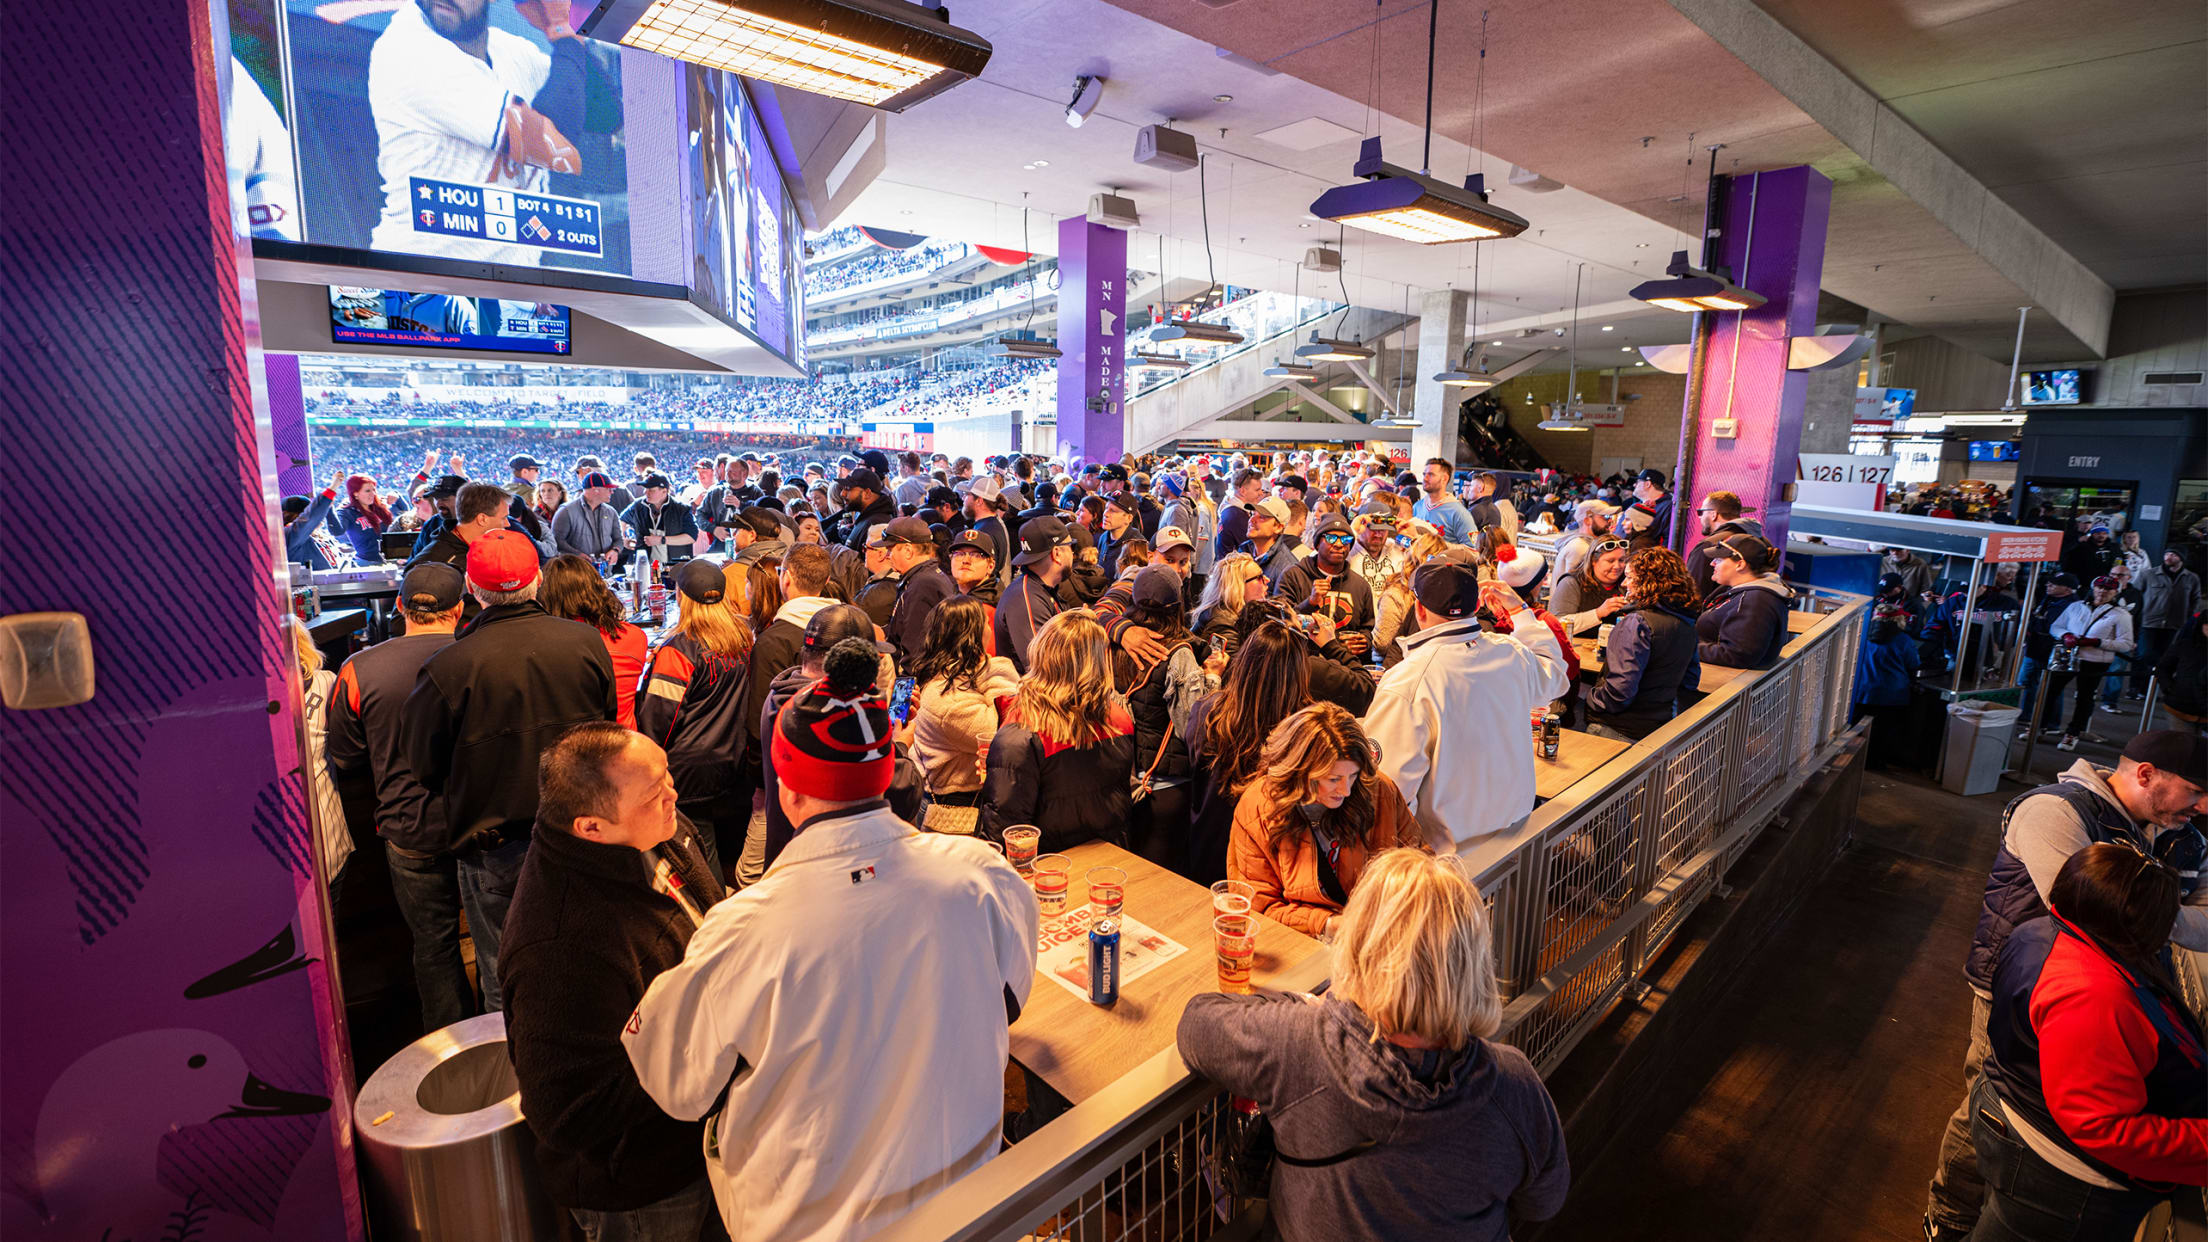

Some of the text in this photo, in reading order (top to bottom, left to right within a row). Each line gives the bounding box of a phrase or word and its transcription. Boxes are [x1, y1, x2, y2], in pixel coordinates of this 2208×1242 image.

[438, 186, 479, 208] HOU
[496, 196, 504, 211] 1
[517, 198, 541, 213] BOT
[542, 202, 550, 214] 4
[442, 212, 506, 235] MIN 0
[557, 229, 597, 246] 2 OUTS
[397, 334, 442, 342] BALLPARK
[1101, 346, 1111, 386] MADE
[446, 388, 606, 397] WELCOME TO TARGET FIELD
[1390, 448, 1408, 458] 126
[2068, 455, 2101, 468] ENTRY
[1811, 465, 1843, 482] 126
[1859, 466, 1891, 483] 127
[1102, 945, 1112, 995] BUD LIGHT
